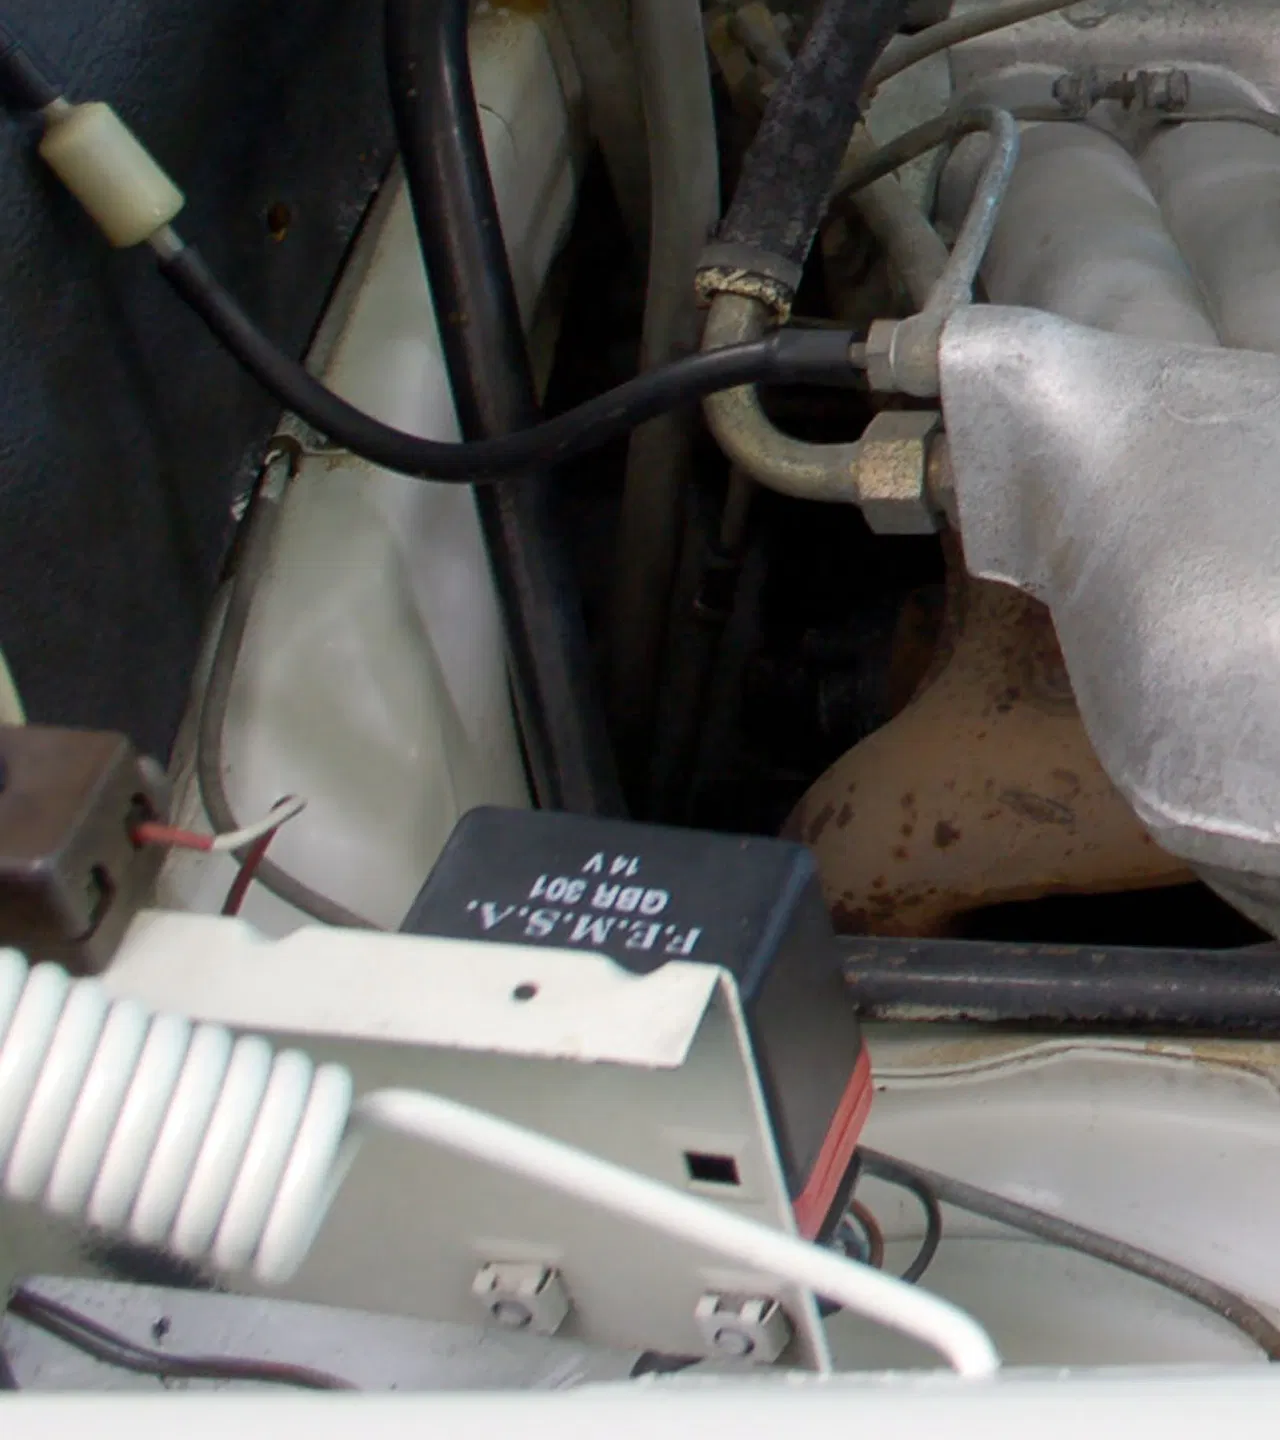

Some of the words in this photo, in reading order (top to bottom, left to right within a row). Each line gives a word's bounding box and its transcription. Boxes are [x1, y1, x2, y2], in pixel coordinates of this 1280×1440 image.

[581, 852, 604, 874] V
[609, 855, 640, 877] 14
[527, 874, 588, 904] 301
[590, 880, 669, 915] GBR
